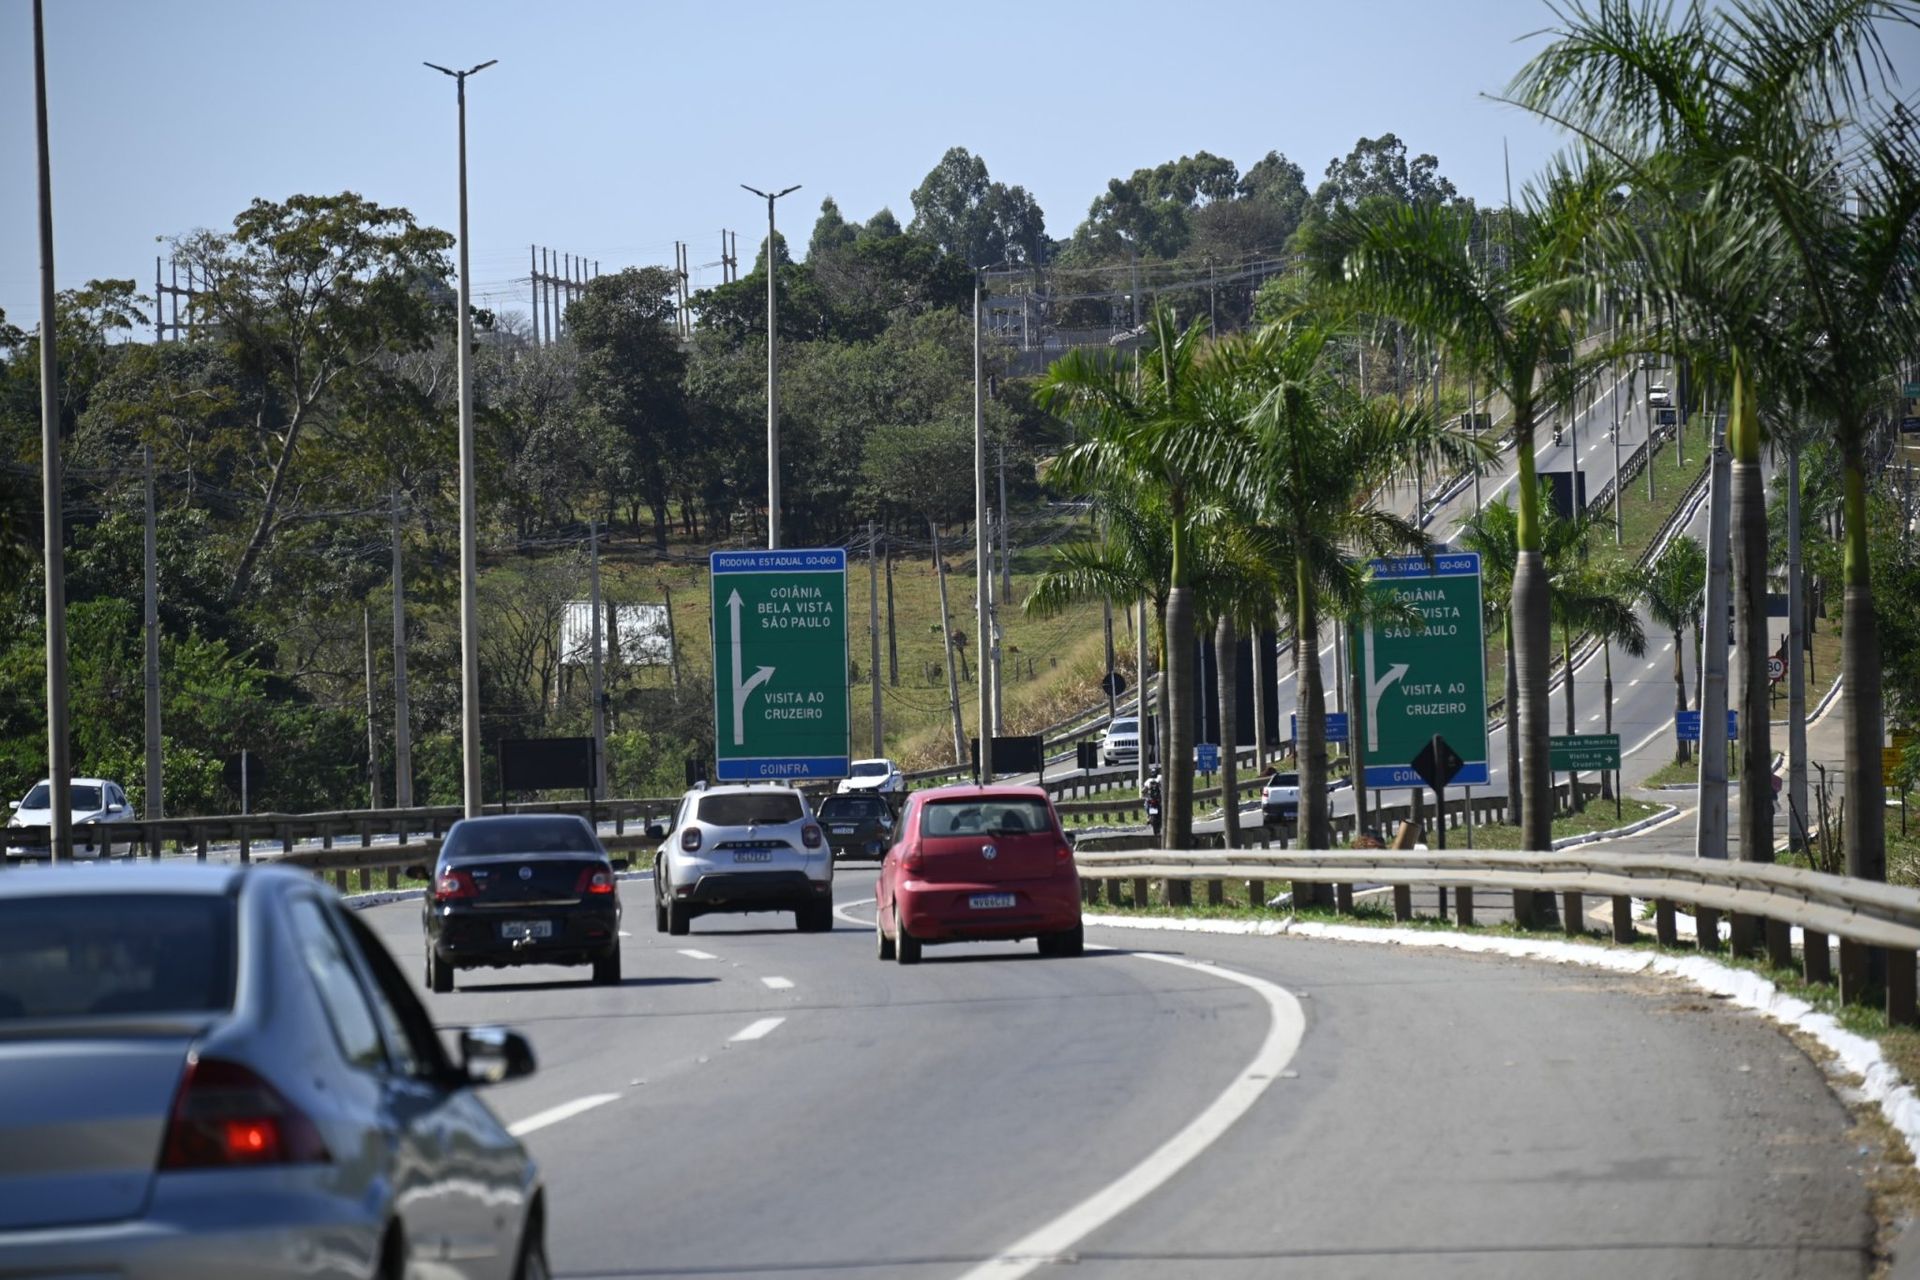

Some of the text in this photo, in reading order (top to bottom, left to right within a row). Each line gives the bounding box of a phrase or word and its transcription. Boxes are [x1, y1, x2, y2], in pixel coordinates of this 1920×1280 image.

[720, 558, 755, 567] RODOVIA
[759, 557, 803, 566] ESTADUAL
[770, 585, 822, 598] GOIÂNIA
[1394, 588, 1446, 602] GOIÂNIA
[758, 602, 833, 613] BELA VISTA
[1422, 607, 1460, 618] VISTA
[762, 616, 830, 628] SÃO PAULO
[1385, 627, 1410, 638] SÃO
[1401, 683, 1465, 695] VISITA AO
[765, 692, 824, 703] VISITA AO
[764, 708, 823, 719] CRUZEIRO
[1406, 703, 1466, 715] CRUZEIRO
[760, 764, 809, 775] GOINFRA
[1394, 770, 1421, 781] GOIN
